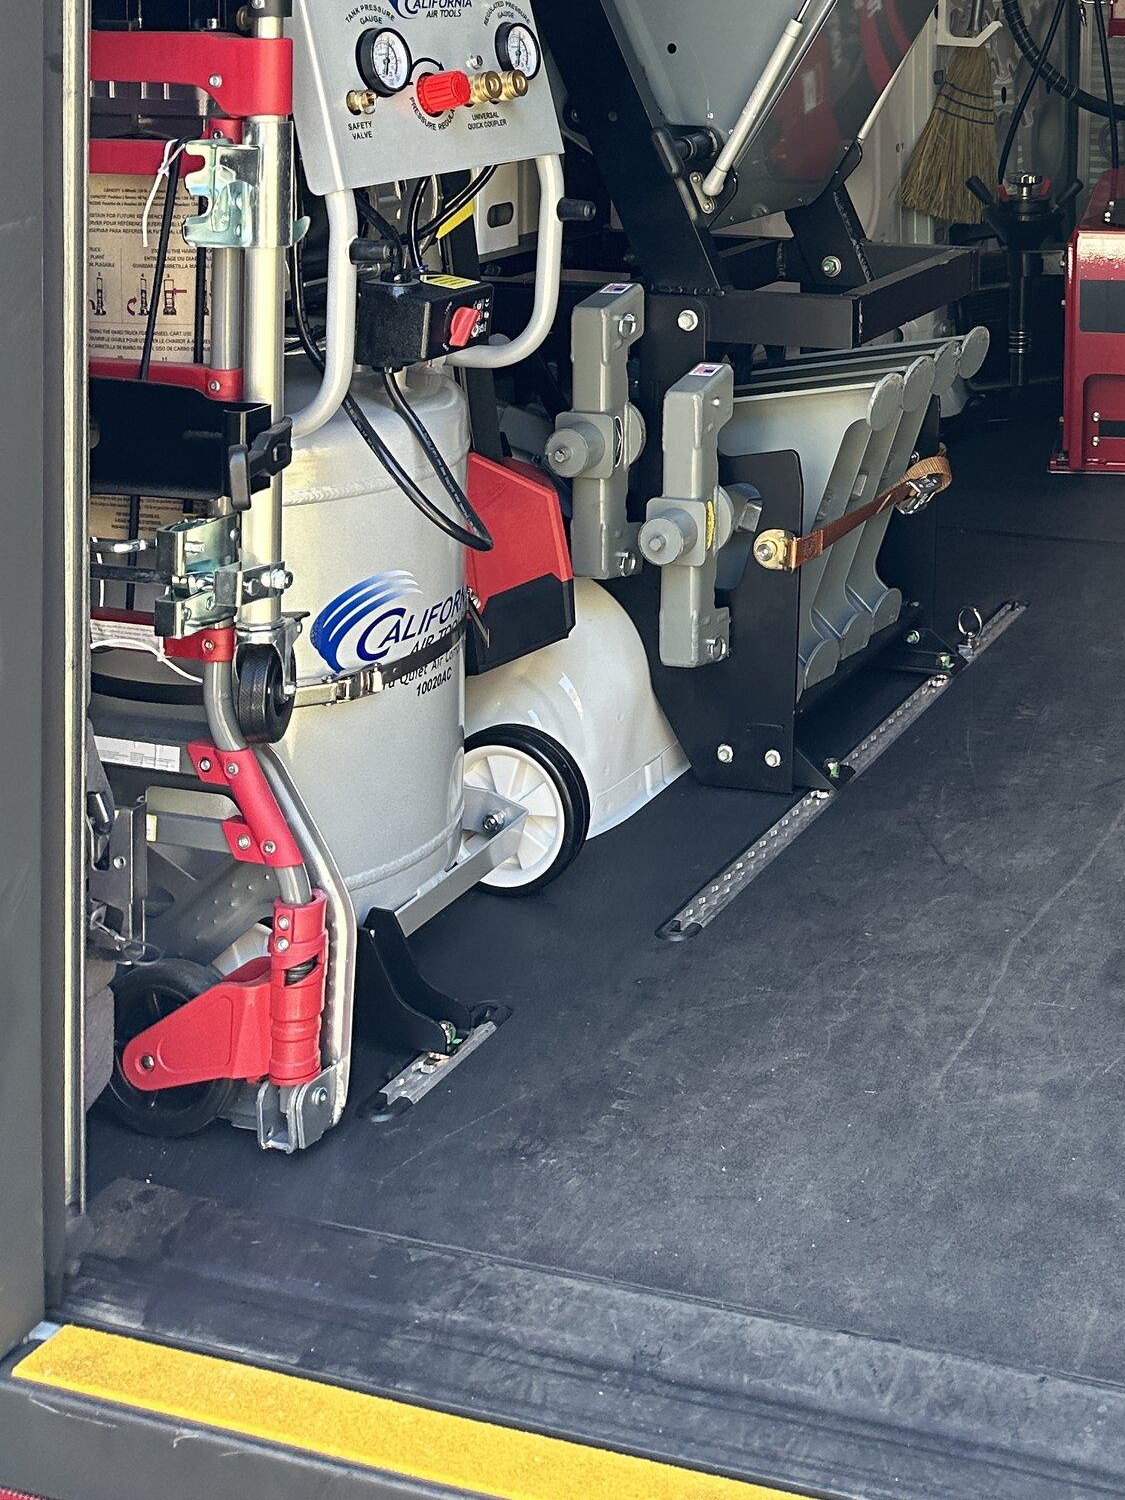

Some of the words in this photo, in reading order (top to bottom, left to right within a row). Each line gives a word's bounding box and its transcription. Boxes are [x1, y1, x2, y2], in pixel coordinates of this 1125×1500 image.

[345, 7, 361, 23] TANK
[360, 3, 395, 22] PRESSURE
[426, 9, 438, 18] AIR
[440, 8, 462, 18] TOOLS
[359, 15, 383, 25] GAUGE
[409, 96, 437, 131] PRESSURE
[471, 111, 500, 121] UNIVERSAL
[347, 120, 373, 130] SAFETY
[467, 121, 483, 130] QUICK
[483, 118, 507, 129] COUPLER
[351, 130, 373, 140] VALVE
[400, 663, 428, 685] Quiet
[416, 666, 452, 697] 10020AC
